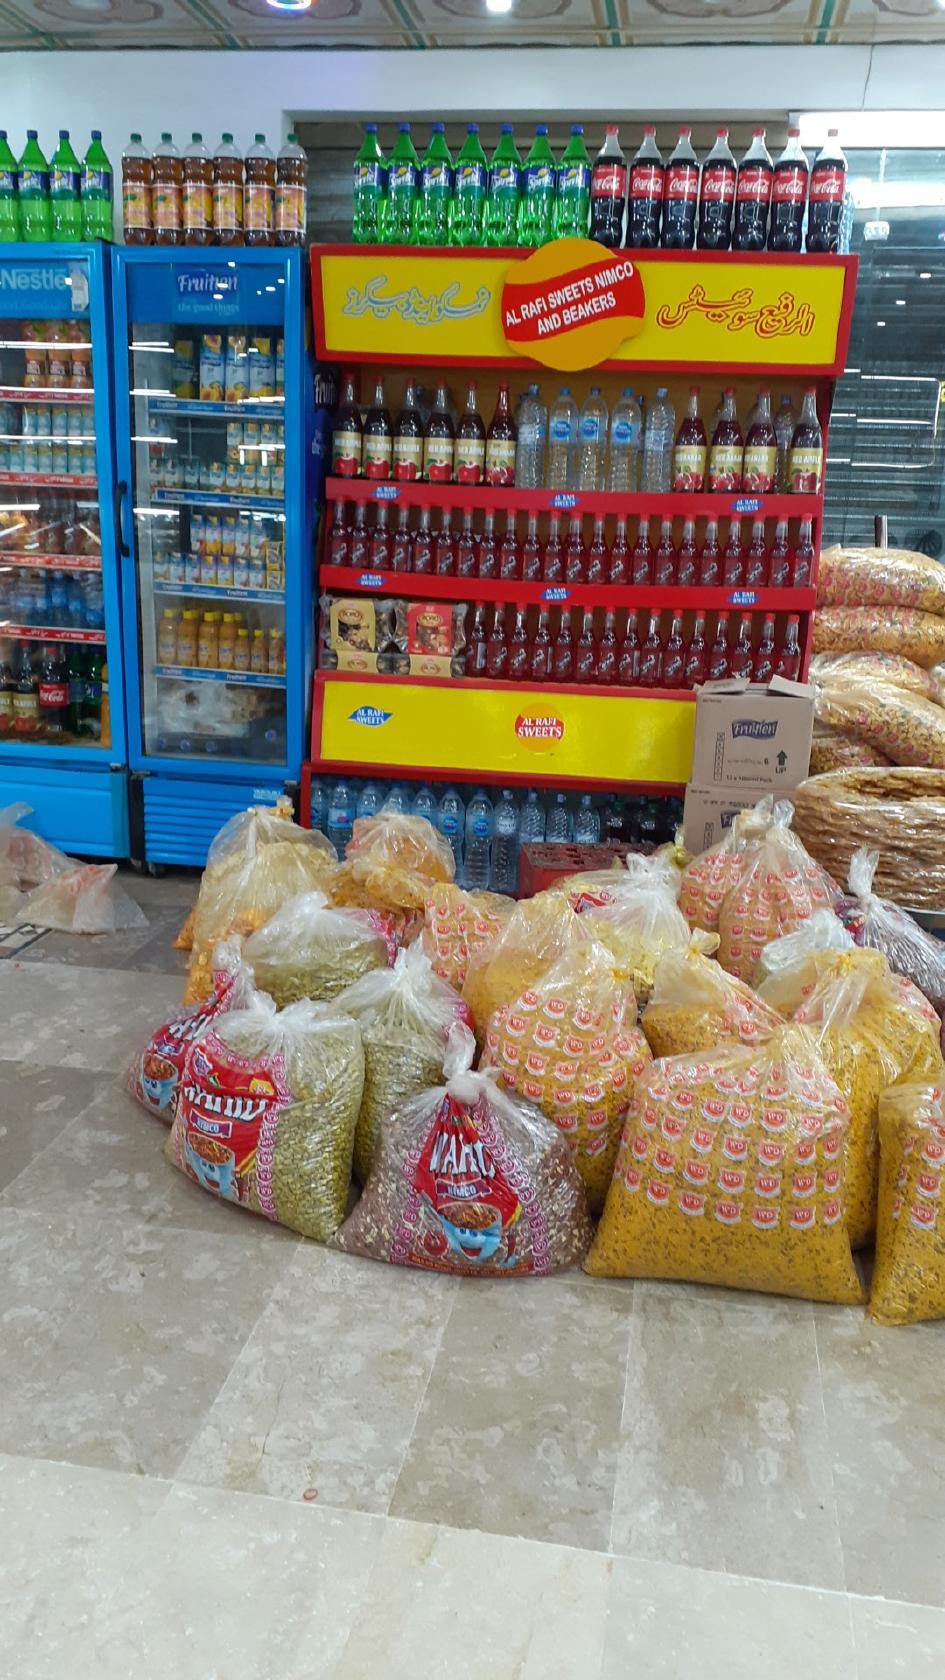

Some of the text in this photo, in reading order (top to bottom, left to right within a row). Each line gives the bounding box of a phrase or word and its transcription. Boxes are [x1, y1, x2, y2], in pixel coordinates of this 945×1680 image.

[505, 262, 634, 327] AL RAFI SWEETS NIMCO
[537, 294, 616, 336] AND BEAKERS
[367, 709, 384, 717] RAFI
[535, 717, 557, 726] RAFI
[517, 726, 562, 739] SWEETS
[775, 766, 787, 774] UP
[448, 1184, 477, 1198] NIMCO
